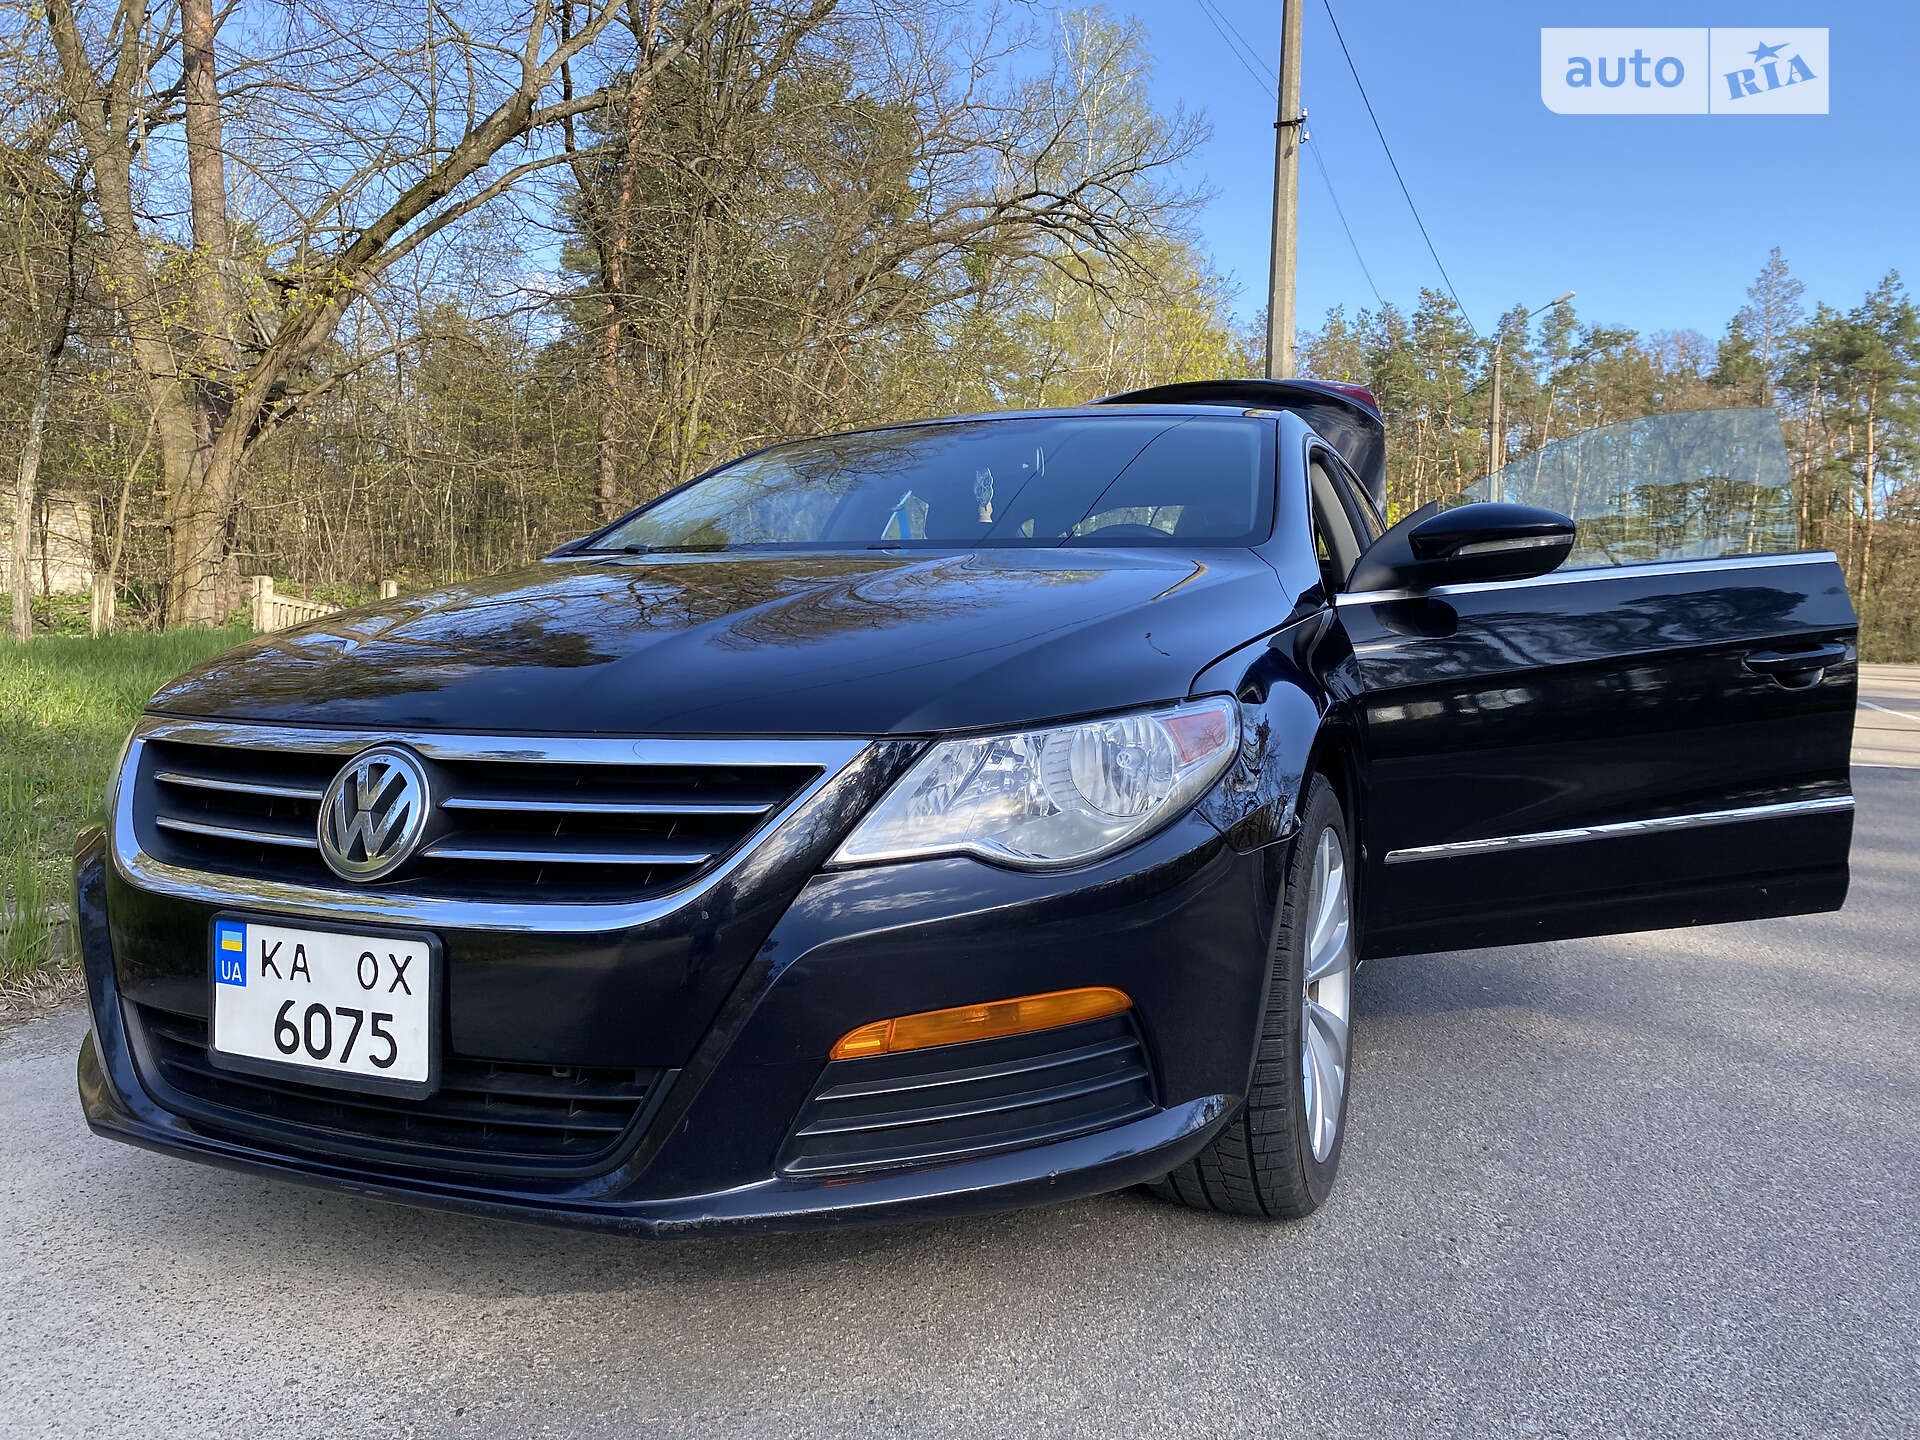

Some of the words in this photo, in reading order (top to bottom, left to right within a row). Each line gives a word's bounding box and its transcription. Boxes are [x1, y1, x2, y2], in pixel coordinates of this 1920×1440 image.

[221, 959, 243, 983] UA
[261, 939, 311, 983] KA
[357, 951, 413, 996] OX
[274, 999, 398, 1069] 6075
